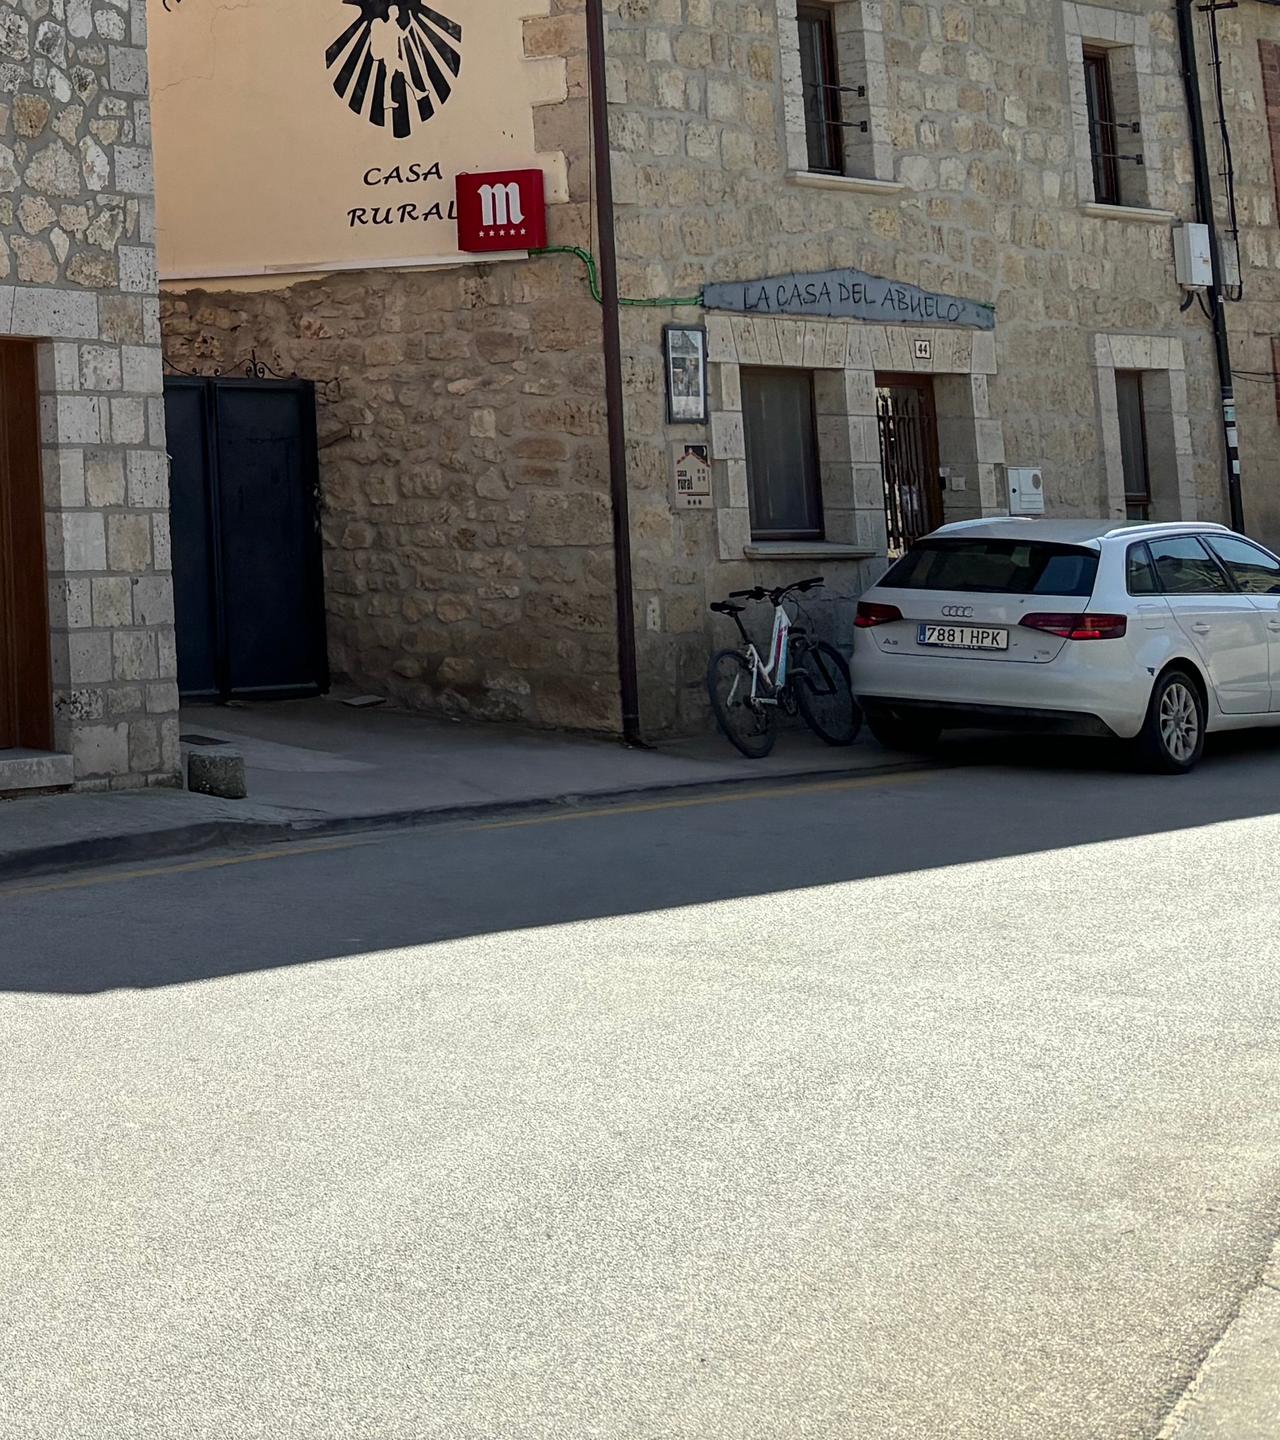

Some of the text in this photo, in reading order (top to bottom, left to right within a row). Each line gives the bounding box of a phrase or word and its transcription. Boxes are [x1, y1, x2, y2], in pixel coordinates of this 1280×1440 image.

[363, 161, 443, 186] CASA
[347, 200, 458, 228] RURAL
[743, 281, 961, 322] LA CASA DEL ABUELO
[917, 343, 928, 356] 44
[677, 475, 693, 491] rural
[927, 627, 1000, 647] 7881 HPK
